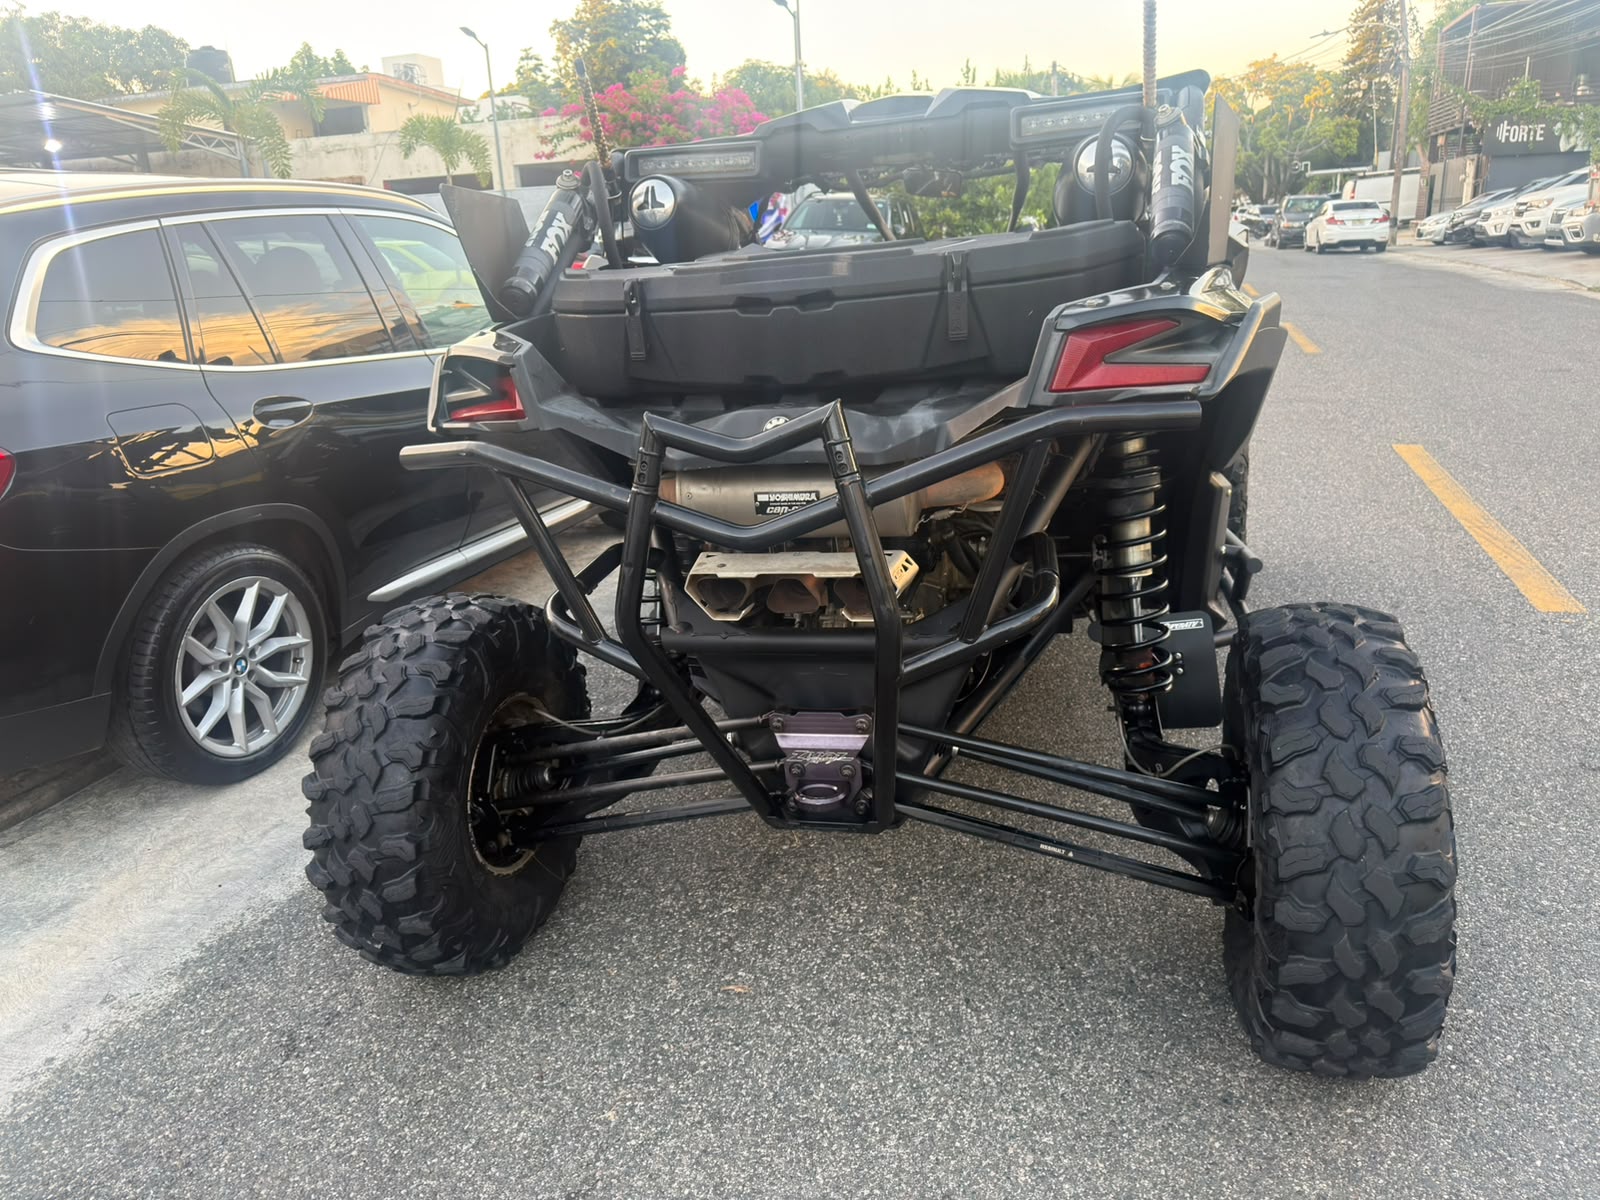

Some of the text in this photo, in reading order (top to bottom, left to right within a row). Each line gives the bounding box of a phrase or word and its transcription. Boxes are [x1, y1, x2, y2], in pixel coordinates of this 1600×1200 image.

[1501, 120, 1546, 143] FORTE
[1169, 144, 1194, 194] FOX
[540, 211, 573, 266] FOX
[769, 492, 818, 502] YOSHIMURA
